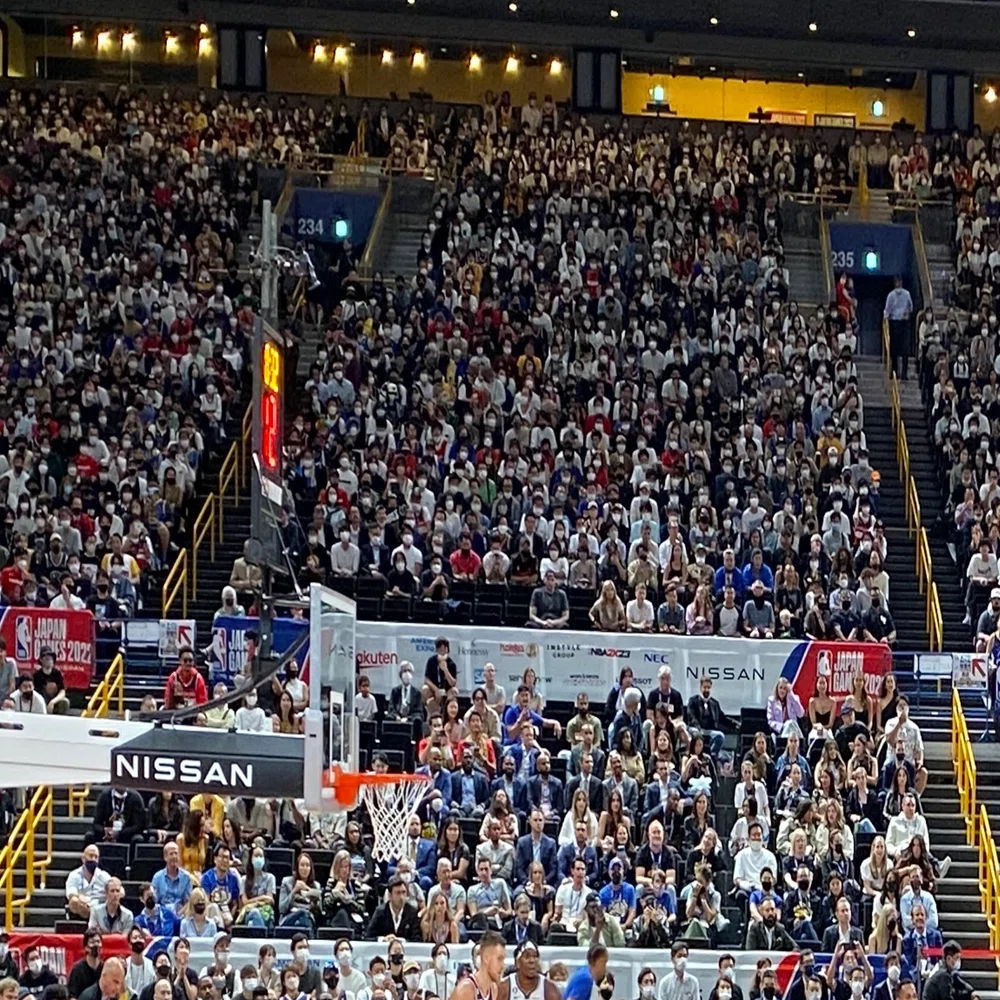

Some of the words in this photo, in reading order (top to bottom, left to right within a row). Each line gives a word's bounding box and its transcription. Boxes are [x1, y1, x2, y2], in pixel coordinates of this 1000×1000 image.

[298, 218, 323, 235] 234
[831, 250, 854, 268] 235
[34, 617, 67, 640] JAPAN
[34, 640, 66, 661] GAES
[356, 650, 399, 665] akuten
[643, 653, 669, 664] NEC
[833, 651, 863, 671] JAPAN
[686, 666, 765, 680] NISSAN
[116, 754, 254, 788] NISSAN
